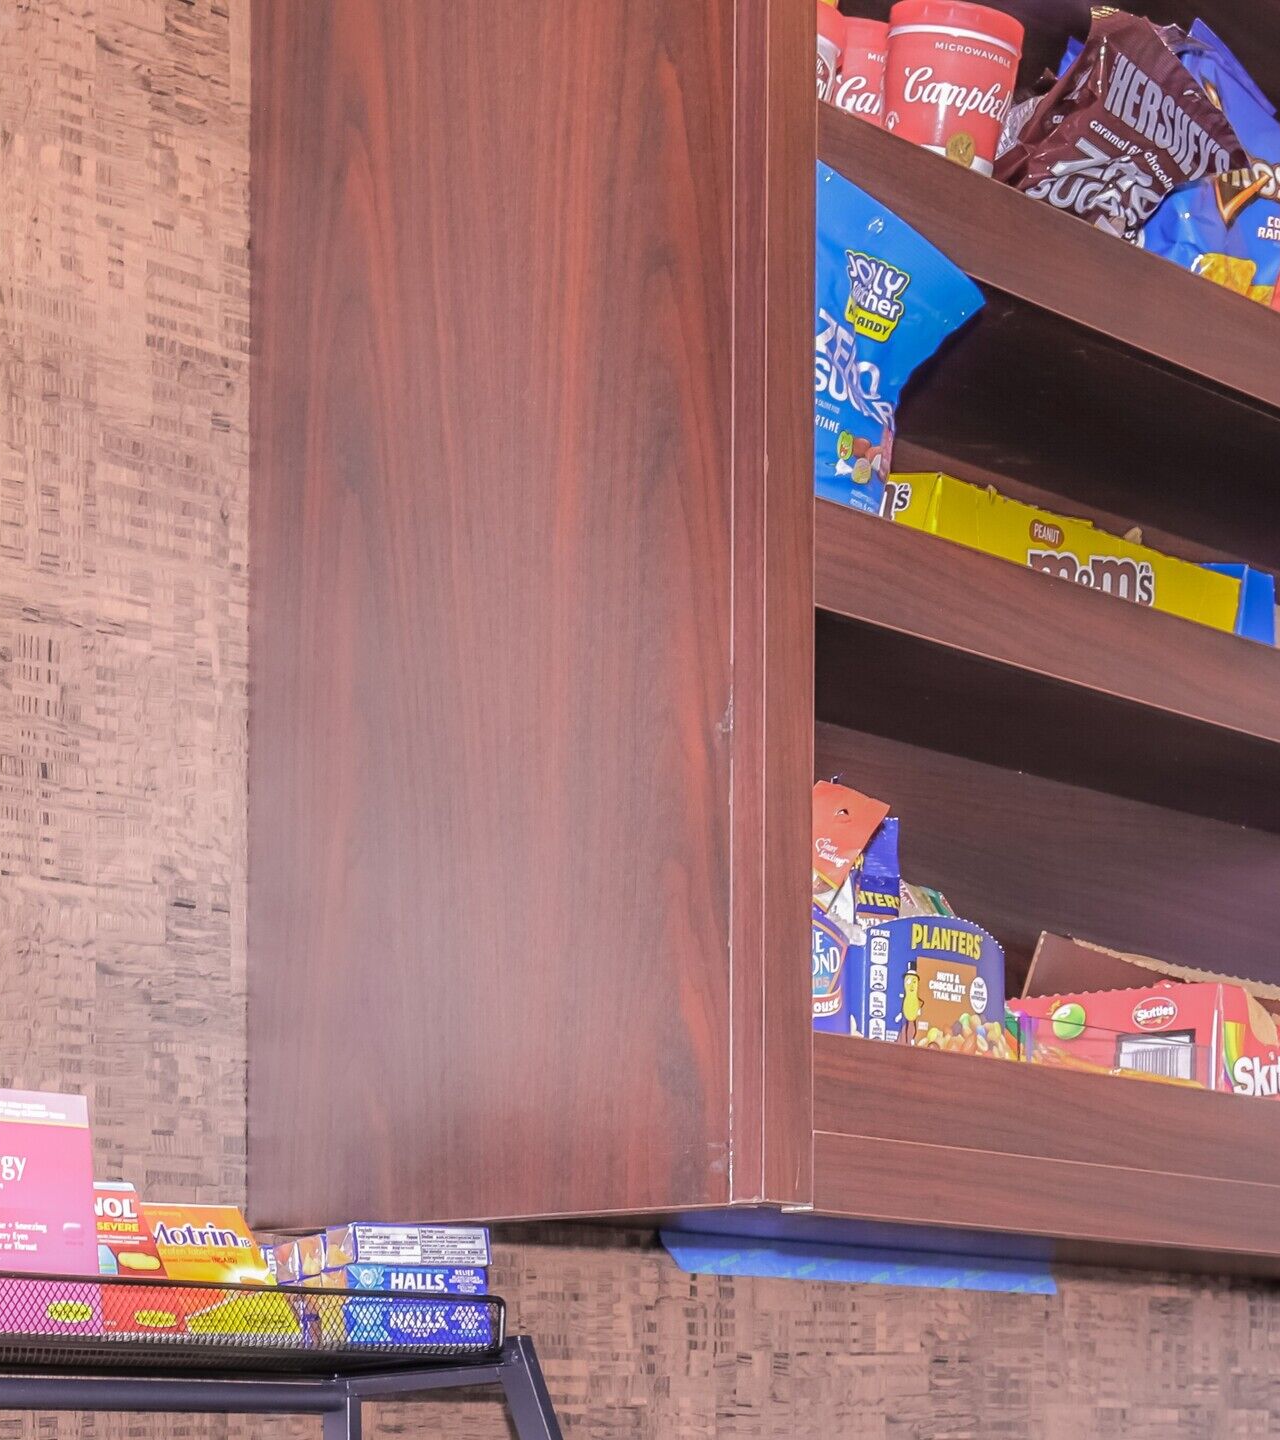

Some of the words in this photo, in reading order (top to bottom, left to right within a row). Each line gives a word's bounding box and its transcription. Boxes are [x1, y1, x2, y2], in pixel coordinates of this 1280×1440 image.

[935, 41, 1011, 69] MICROWAVABLE
[1104, 53, 1231, 182] HERSHEY'S
[1089, 120, 1130, 150] caramel
[1033, 523, 1061, 544] PEANUT
[873, 940, 888, 952] 250
[912, 922, 983, 961] PLANTERS
[929, 980, 967, 995] CHOCOLATE
[933, 991, 950, 1002] TRAIL
[951, 993, 963, 1003] MIX
[1134, 1005, 1175, 1021] Skittles
[96, 1221, 139, 1233] SEVERE
[12, 1231, 29, 1242] Eyes
[4, 1242, 13, 1250] or
